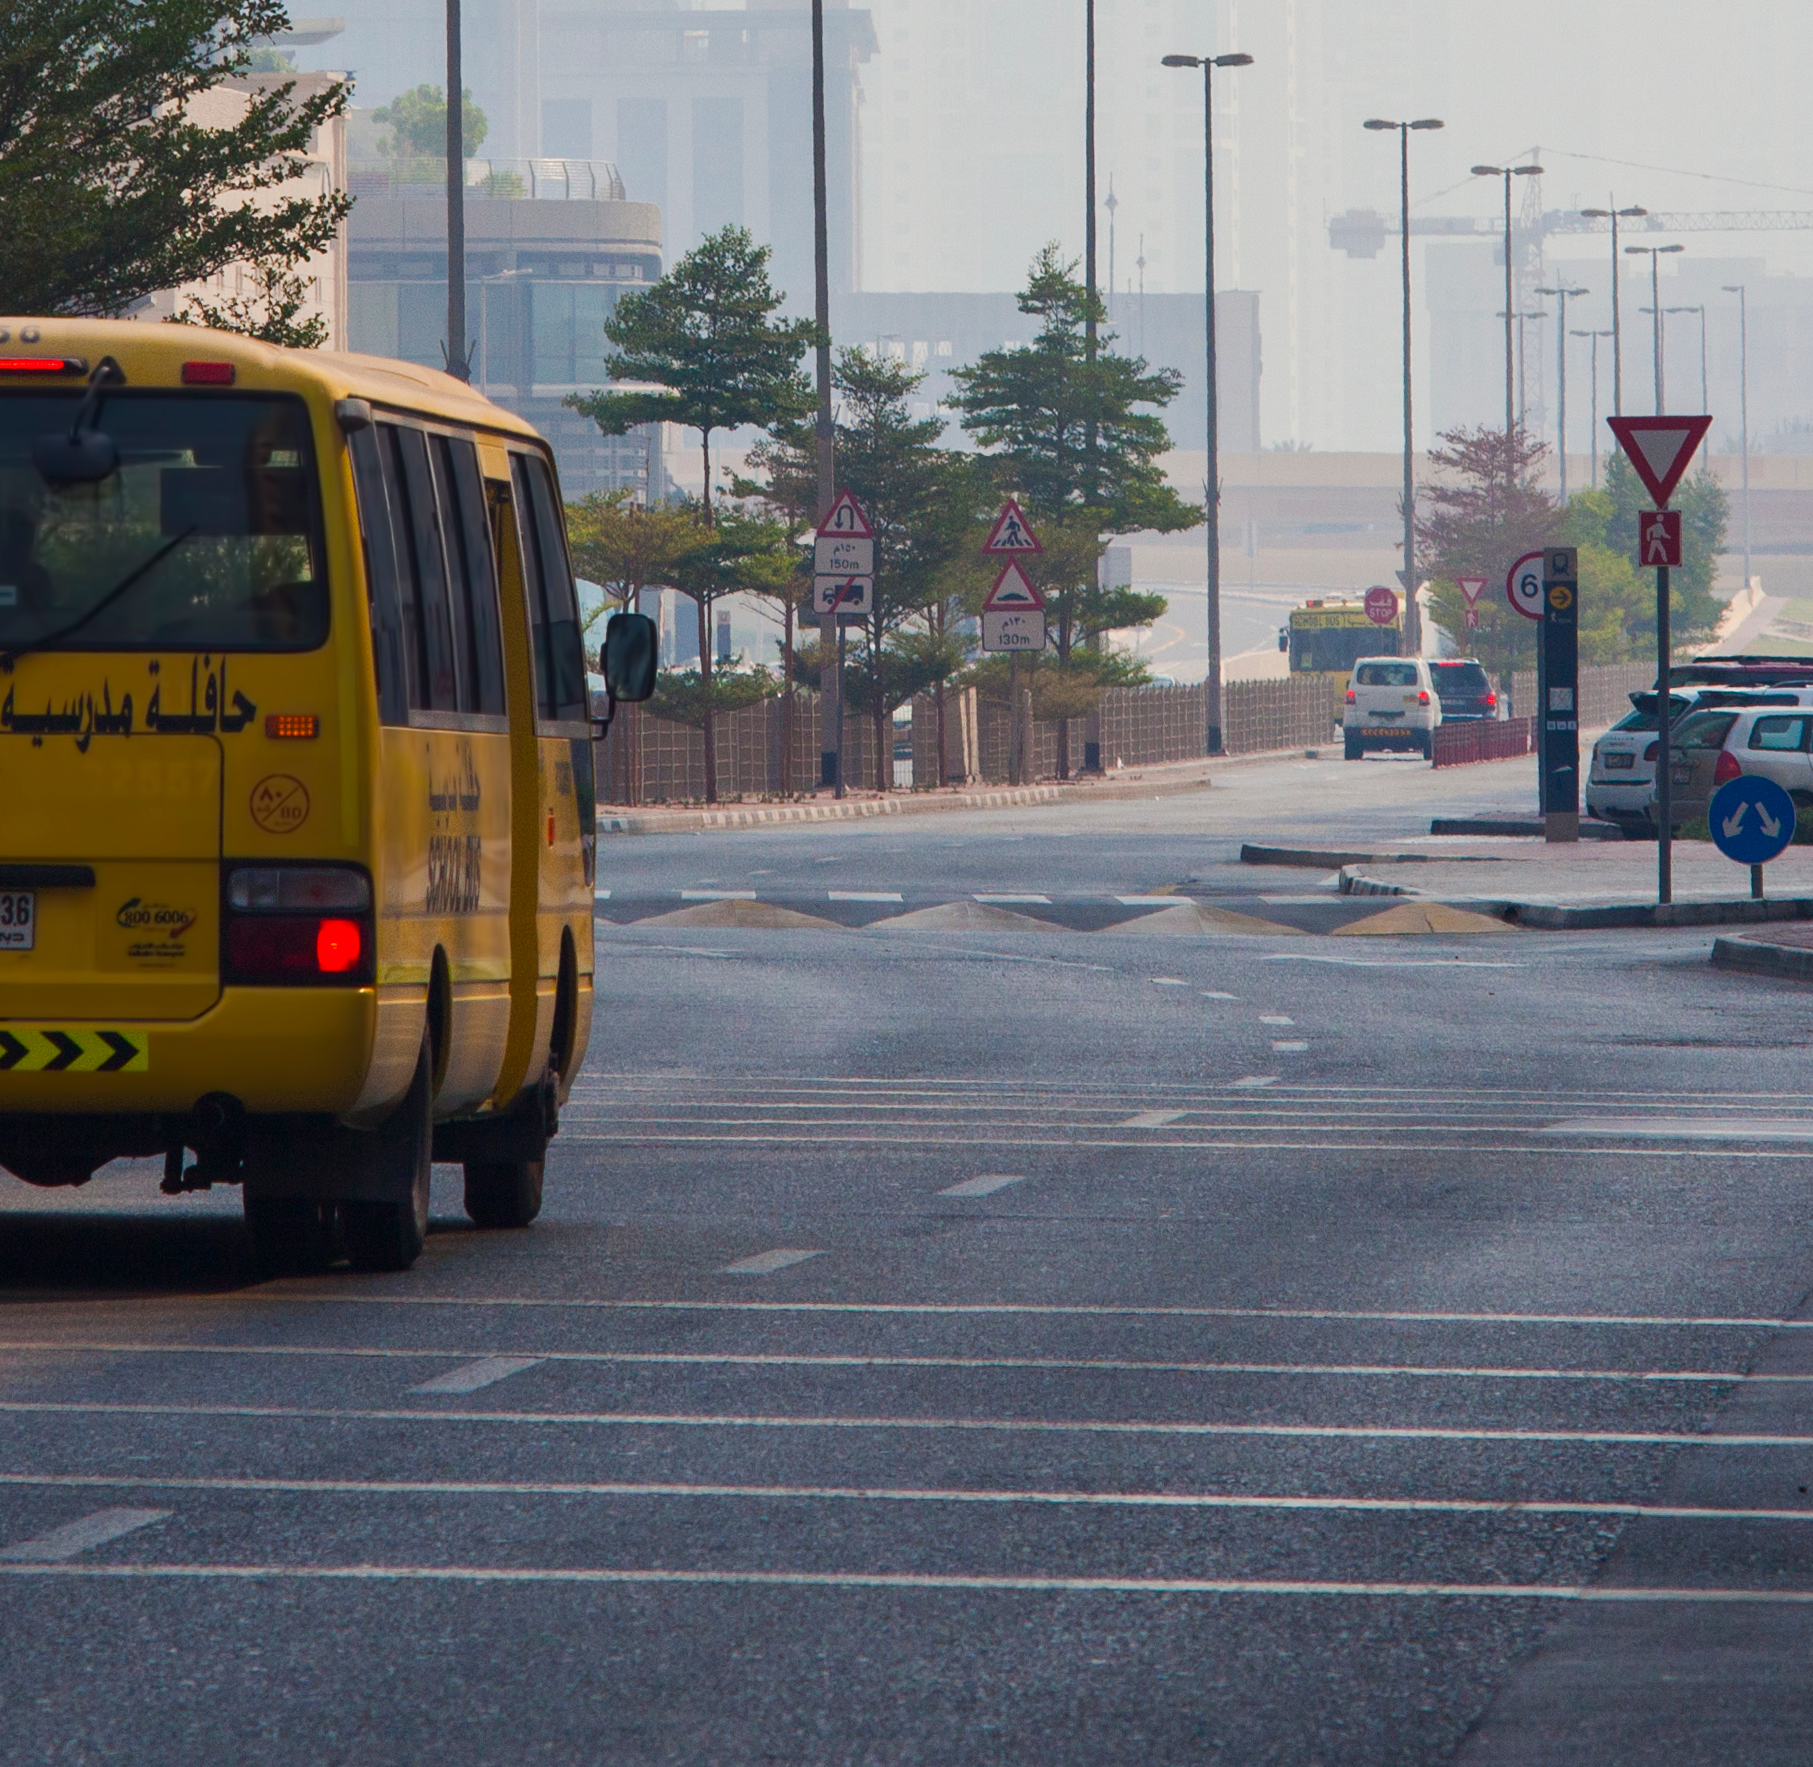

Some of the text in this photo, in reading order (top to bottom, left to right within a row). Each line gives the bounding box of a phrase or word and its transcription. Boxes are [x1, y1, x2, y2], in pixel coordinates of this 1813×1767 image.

[829, 558, 859, 570] 150m
[1520, 574, 1538, 599] 6
[1370, 608, 1393, 618] STOP
[999, 634, 1030, 646] 130m
[0, 653, 257, 754] حافلة مدرسية
[124, 910, 189, 924] 800 6006
